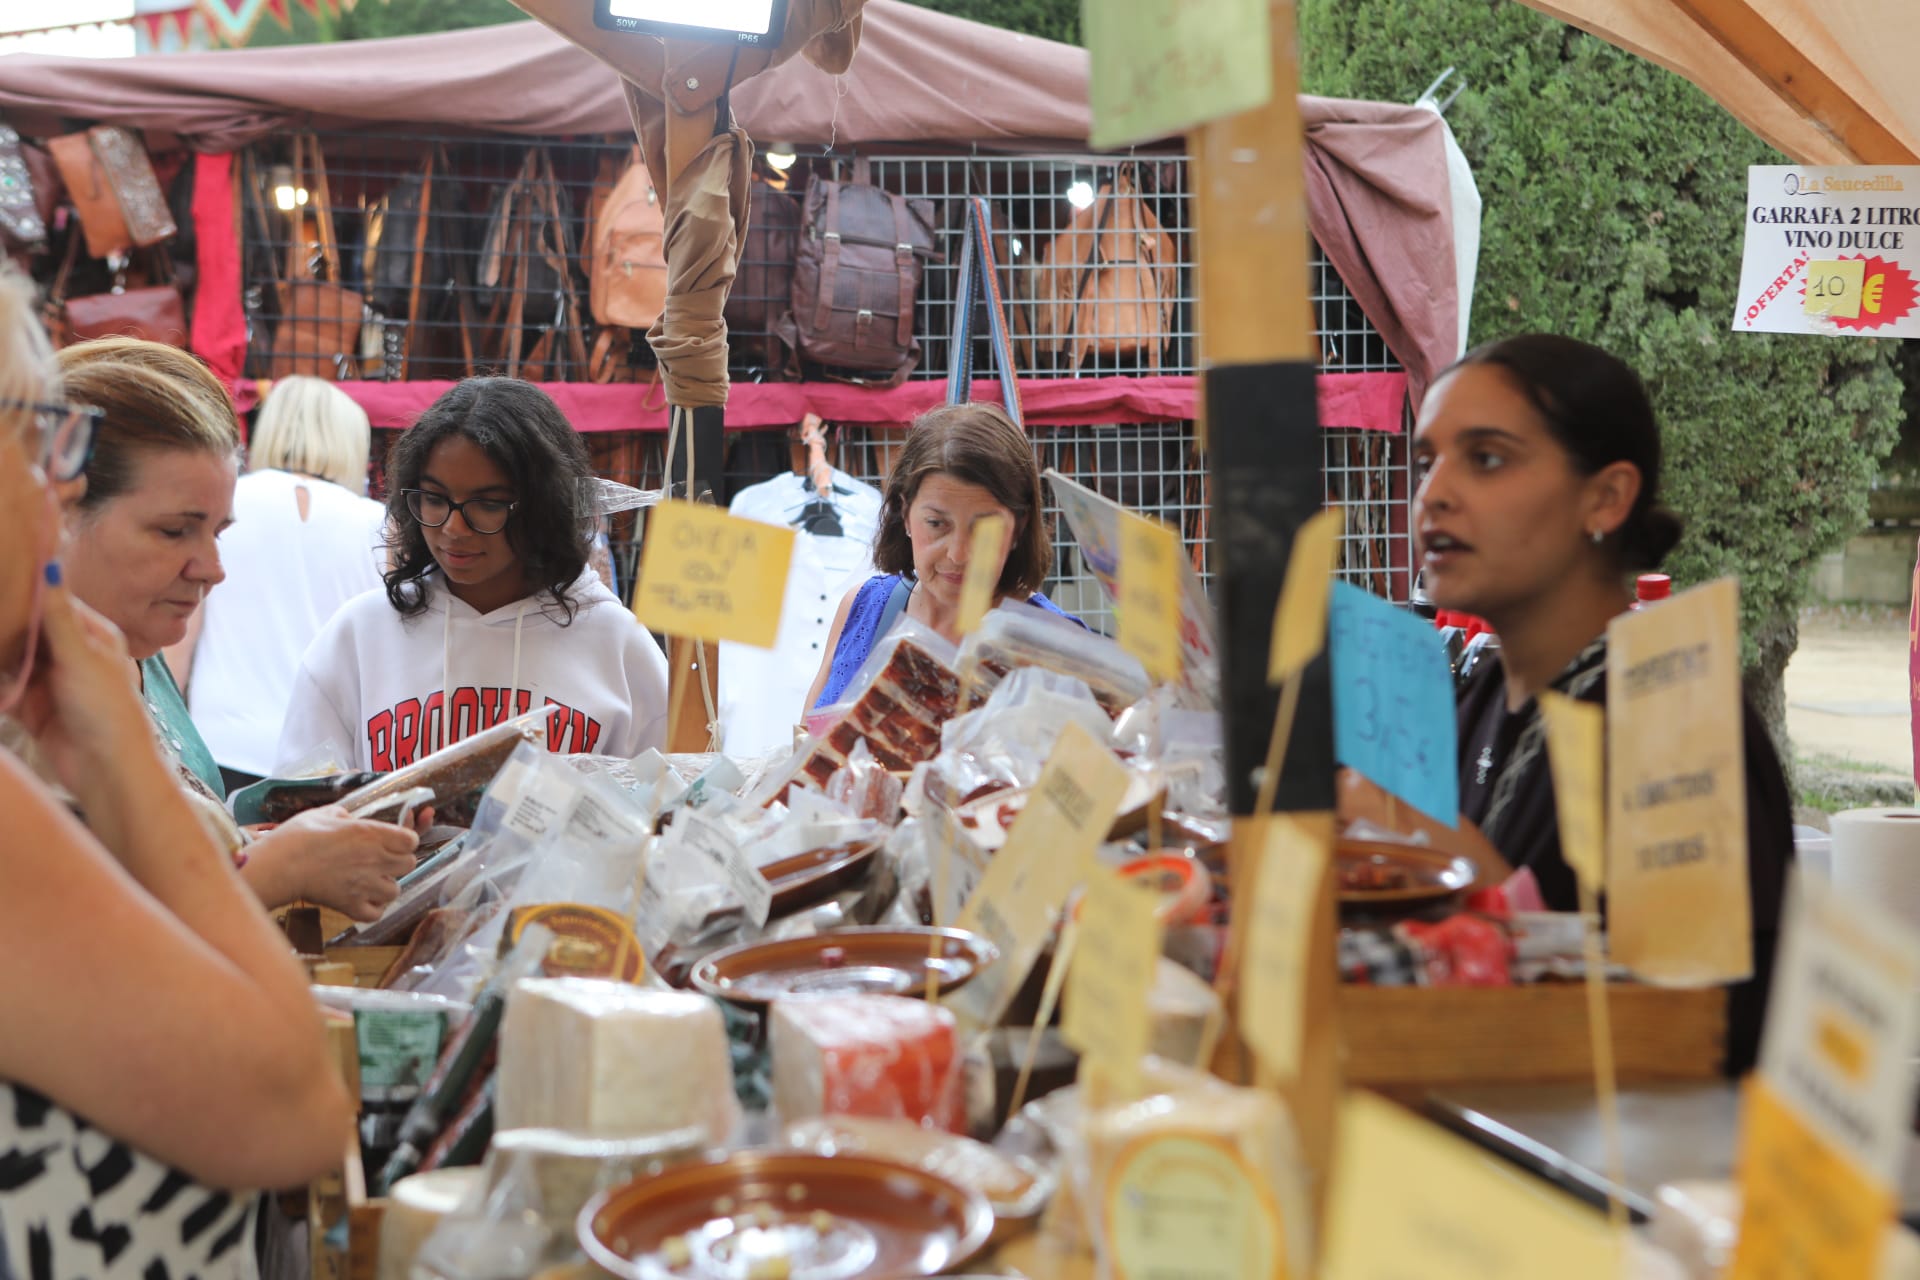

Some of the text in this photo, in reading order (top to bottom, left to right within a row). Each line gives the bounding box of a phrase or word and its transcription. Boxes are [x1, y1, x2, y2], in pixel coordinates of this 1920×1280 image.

[615, 18, 638, 28] 50W
[738, 33, 759, 44] IP65
[1823, 175, 1904, 192] Saucedilla
[1752, 206, 1845, 225] GARRAFA
[1850, 207, 1862, 225] 2
[1784, 230, 1905, 250] VINO DULCE
[1813, 273, 1885, 314] 10 €
